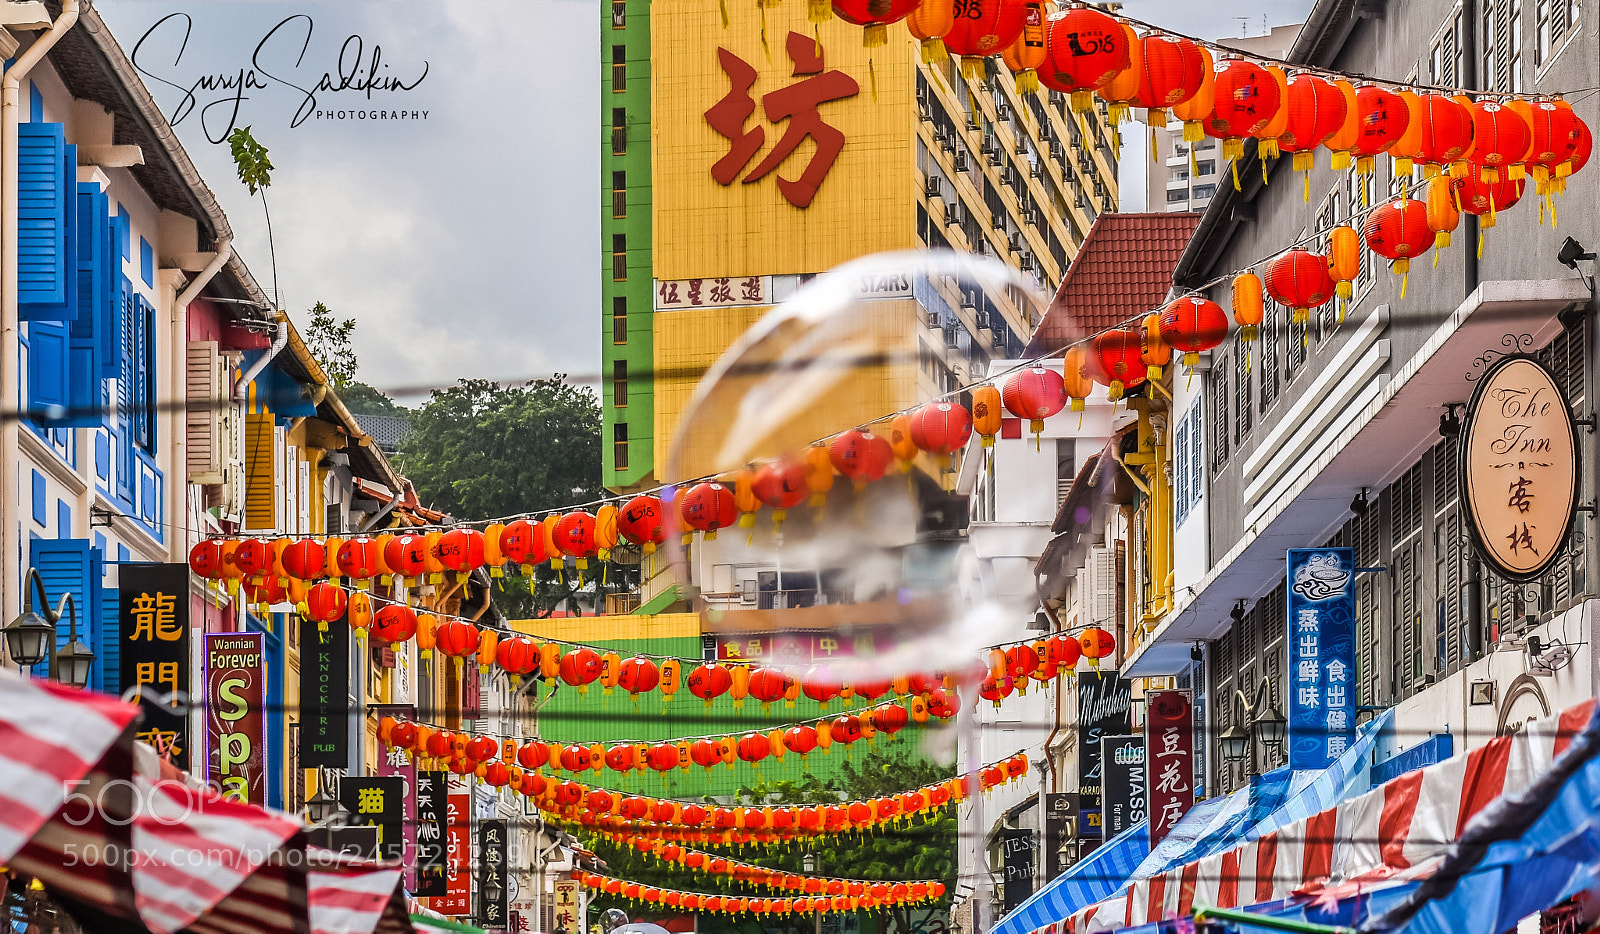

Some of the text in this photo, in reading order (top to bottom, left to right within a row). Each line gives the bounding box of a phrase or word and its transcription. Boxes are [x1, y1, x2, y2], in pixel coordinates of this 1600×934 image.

[704, 30, 860, 208] 坊
[860, 271, 909, 294] STARS
[1491, 387, 1551, 418] The
[1490, 424, 1551, 455] Inn
[1506, 476, 1539, 557] 客栈
[209, 651, 260, 669] Forever
[214, 639, 255, 650] Wannian
[724, 640, 763, 658] 食品
[1298, 609, 1320, 709] 蒸出鲜味
[318, 652, 331, 736] KNOCKERS
[1326, 659, 1347, 759] 食出健康
[218, 677, 252, 804] Spa
[313, 744, 335, 752] PUB
[1080, 786, 1102, 796] KARAO
[1129, 767, 1145, 826] MASS
[1156, 726, 1189, 832] 豆花庄
[1113, 804, 1123, 815] For
[485, 829, 502, 921] 风波庄家
